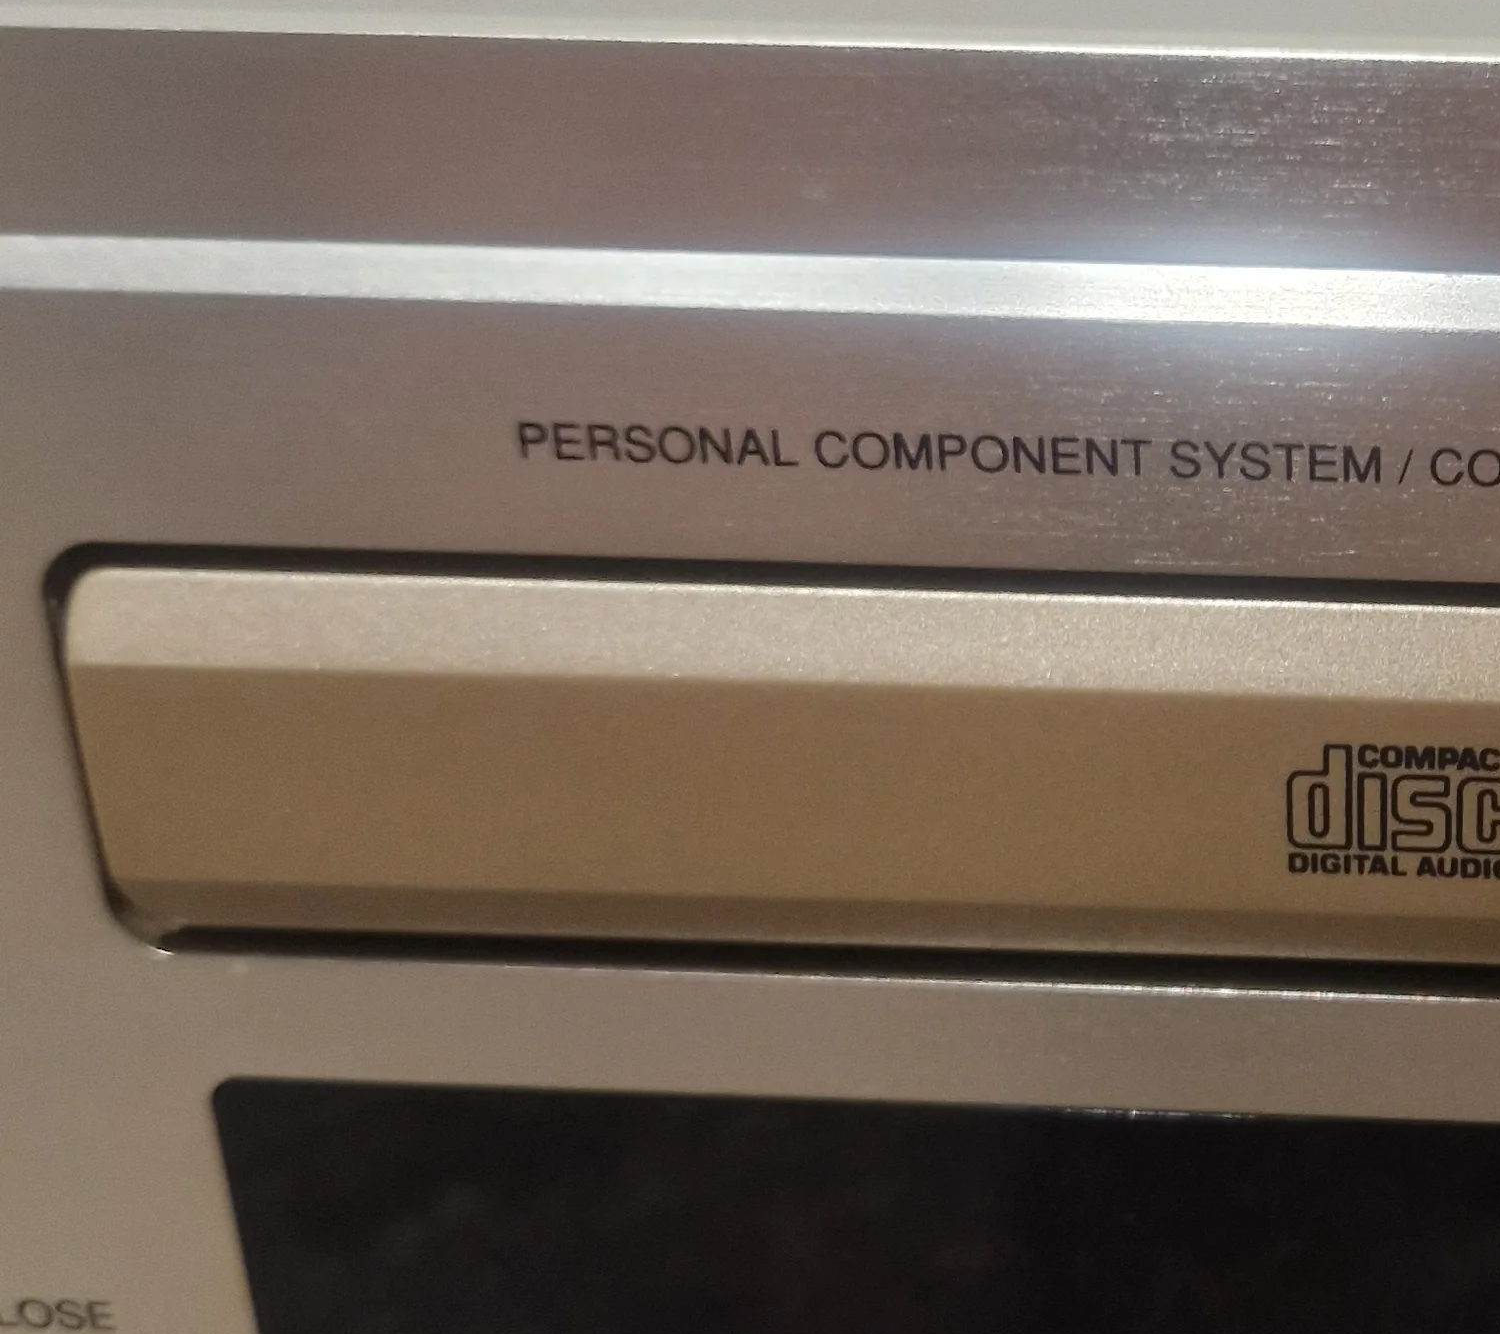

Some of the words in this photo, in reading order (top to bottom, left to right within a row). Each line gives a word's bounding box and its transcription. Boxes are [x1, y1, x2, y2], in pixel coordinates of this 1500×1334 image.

[517, 421, 799, 468] PERSONAL
[813, 429, 1153, 477] COMPONENT
[1169, 440, 1382, 484] SYSTEM
[1287, 852, 1407, 876] DIGITAL
